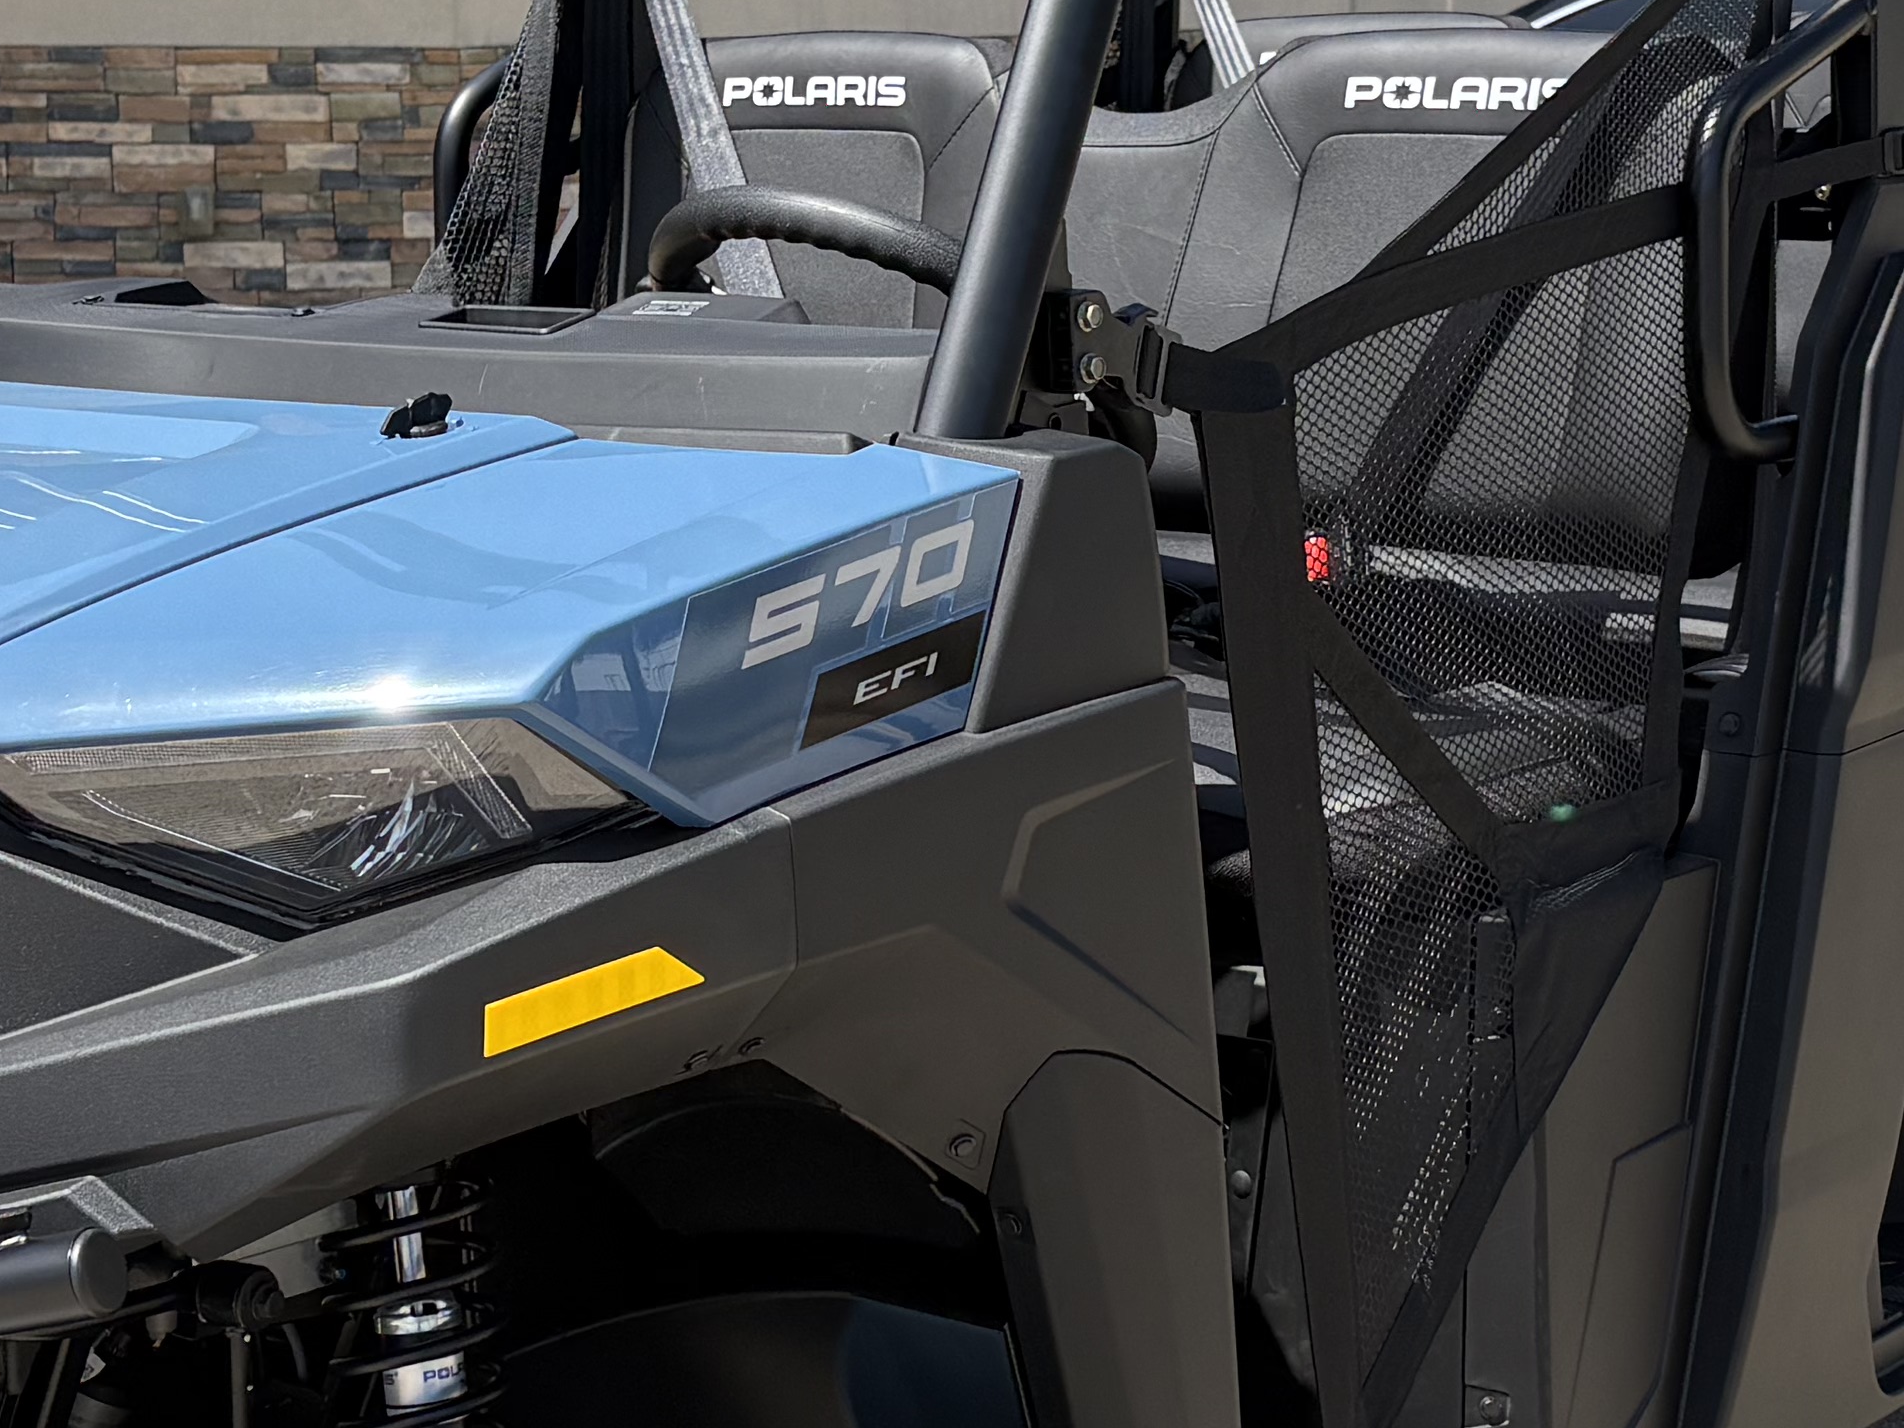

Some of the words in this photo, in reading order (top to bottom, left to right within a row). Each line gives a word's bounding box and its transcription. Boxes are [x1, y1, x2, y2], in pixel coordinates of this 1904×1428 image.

[722, 75, 907, 107] POLARIS
[741, 518, 975, 670] 570
[853, 651, 939, 706] EFI
